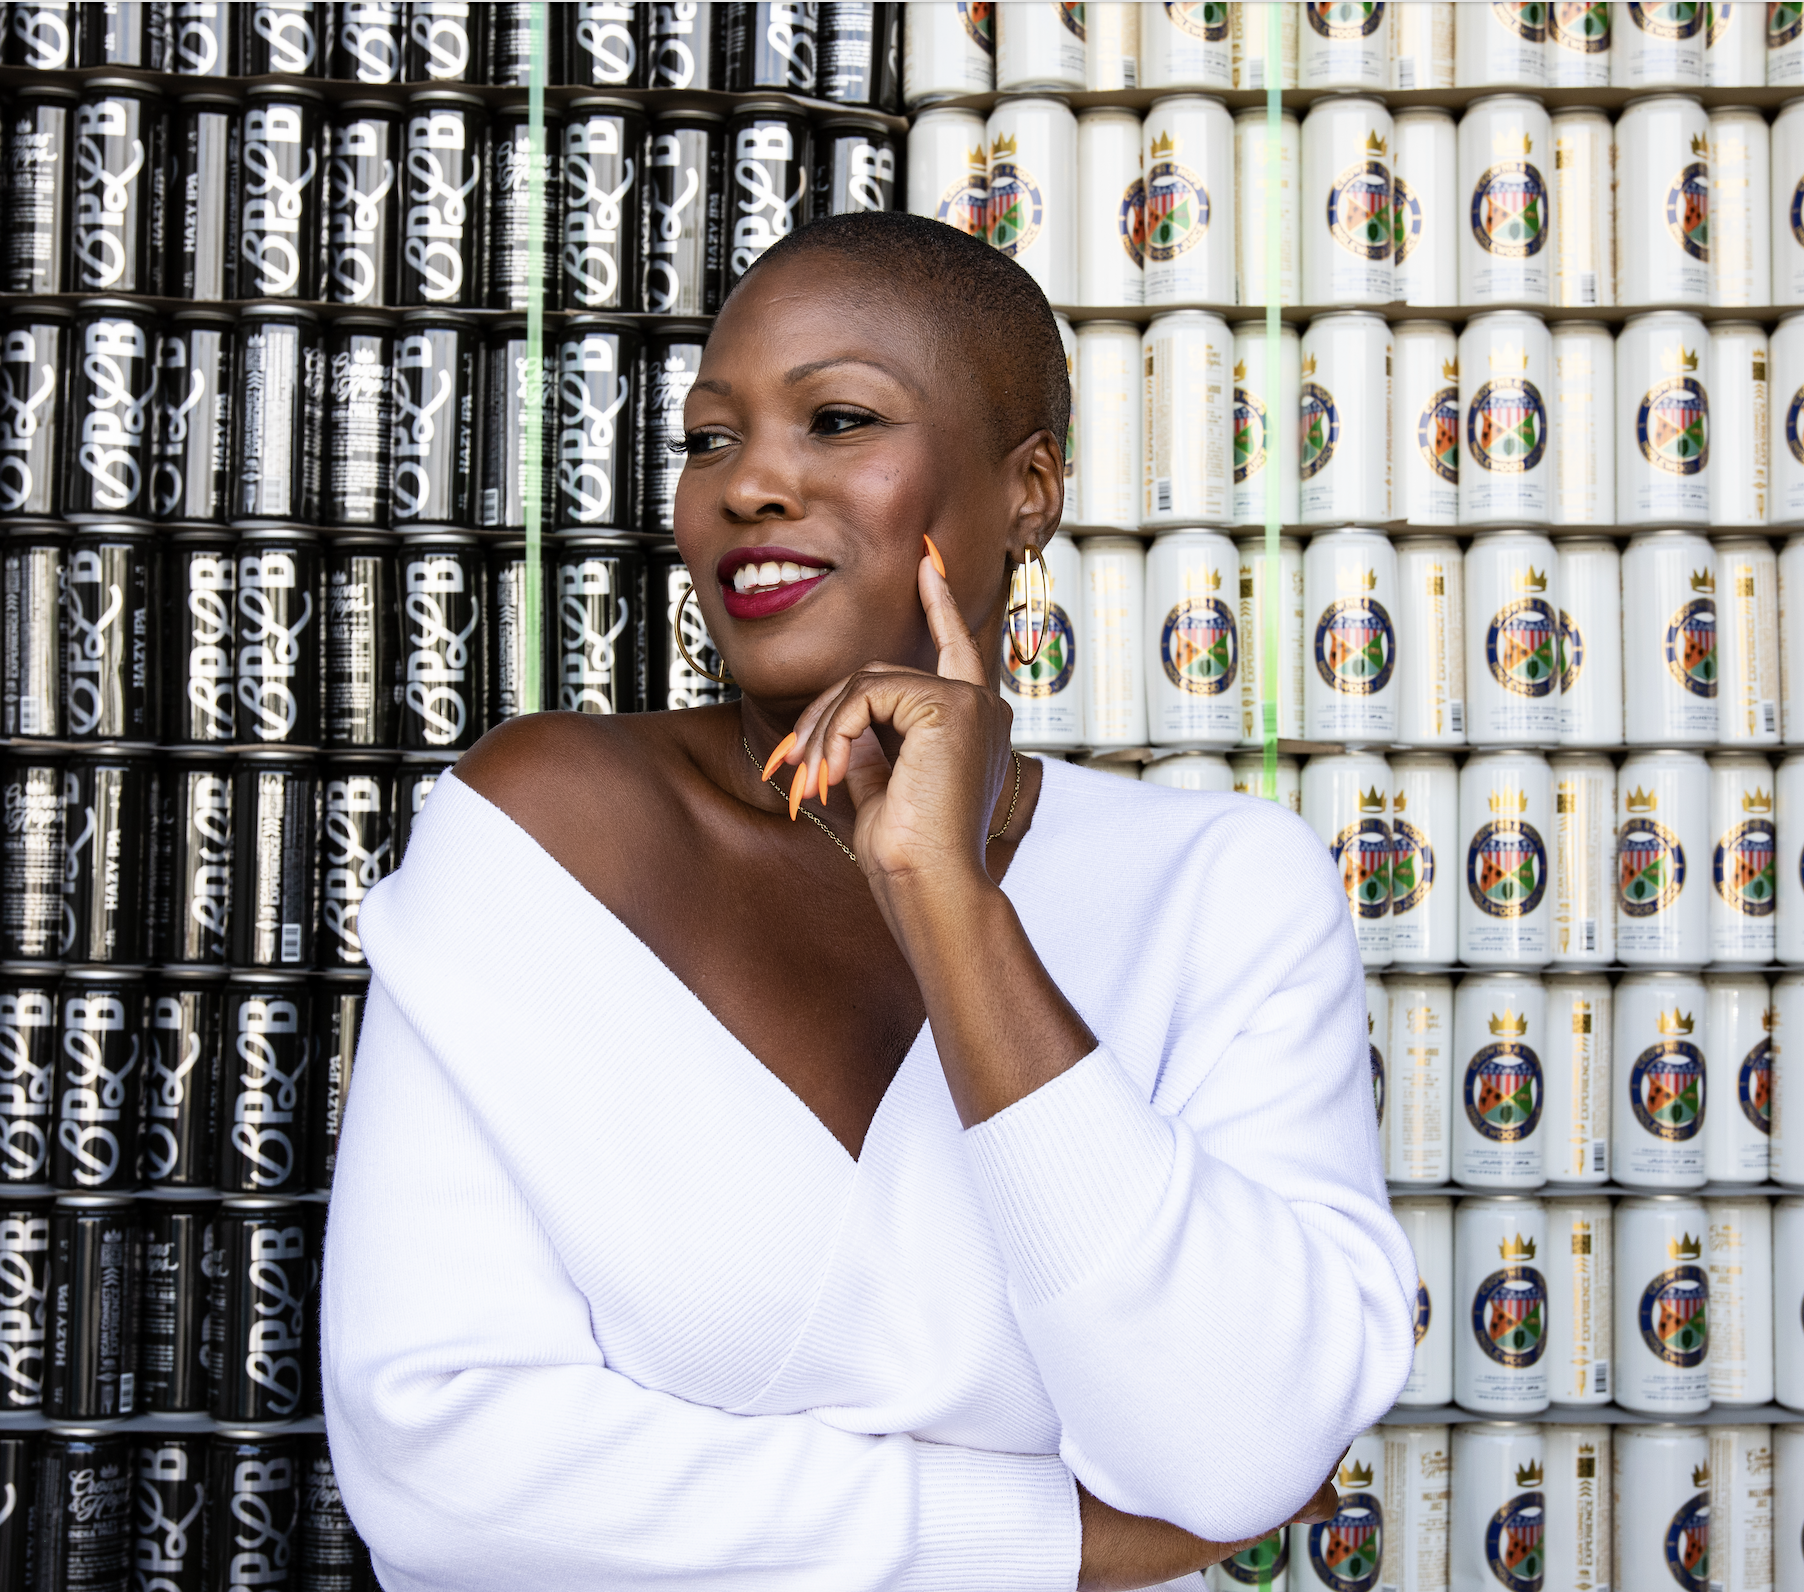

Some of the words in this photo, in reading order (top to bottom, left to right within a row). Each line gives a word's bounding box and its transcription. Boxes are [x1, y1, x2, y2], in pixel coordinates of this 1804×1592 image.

[184, 172, 198, 200] IPA
[241, 107, 317, 294] BPLB
[404, 114, 480, 301] BPLB
[563, 119, 634, 303] BPLB
[183, 207, 197, 253] HAZY
[330, 351, 391, 379] Crowns
[79, 321, 158, 508] BPLB
[557, 337, 628, 521] BPLB
[134, 607, 146, 635] IPA
[238, 554, 313, 740] BPLB
[133, 639, 146, 688] HAZY
[406, 558, 479, 745] BPLB
[106, 828, 120, 857] IPA
[104, 860, 119, 910] HAZY
[59, 997, 138, 1185] BPLB
[231, 1001, 308, 1187] BPLB
[328, 1054, 342, 1084] IPA
[326, 1086, 341, 1136] HAZY
[56, 1283, 69, 1312] IPA
[55, 1315, 68, 1367] HAZY
[230, 1457, 298, 1592] PLB
